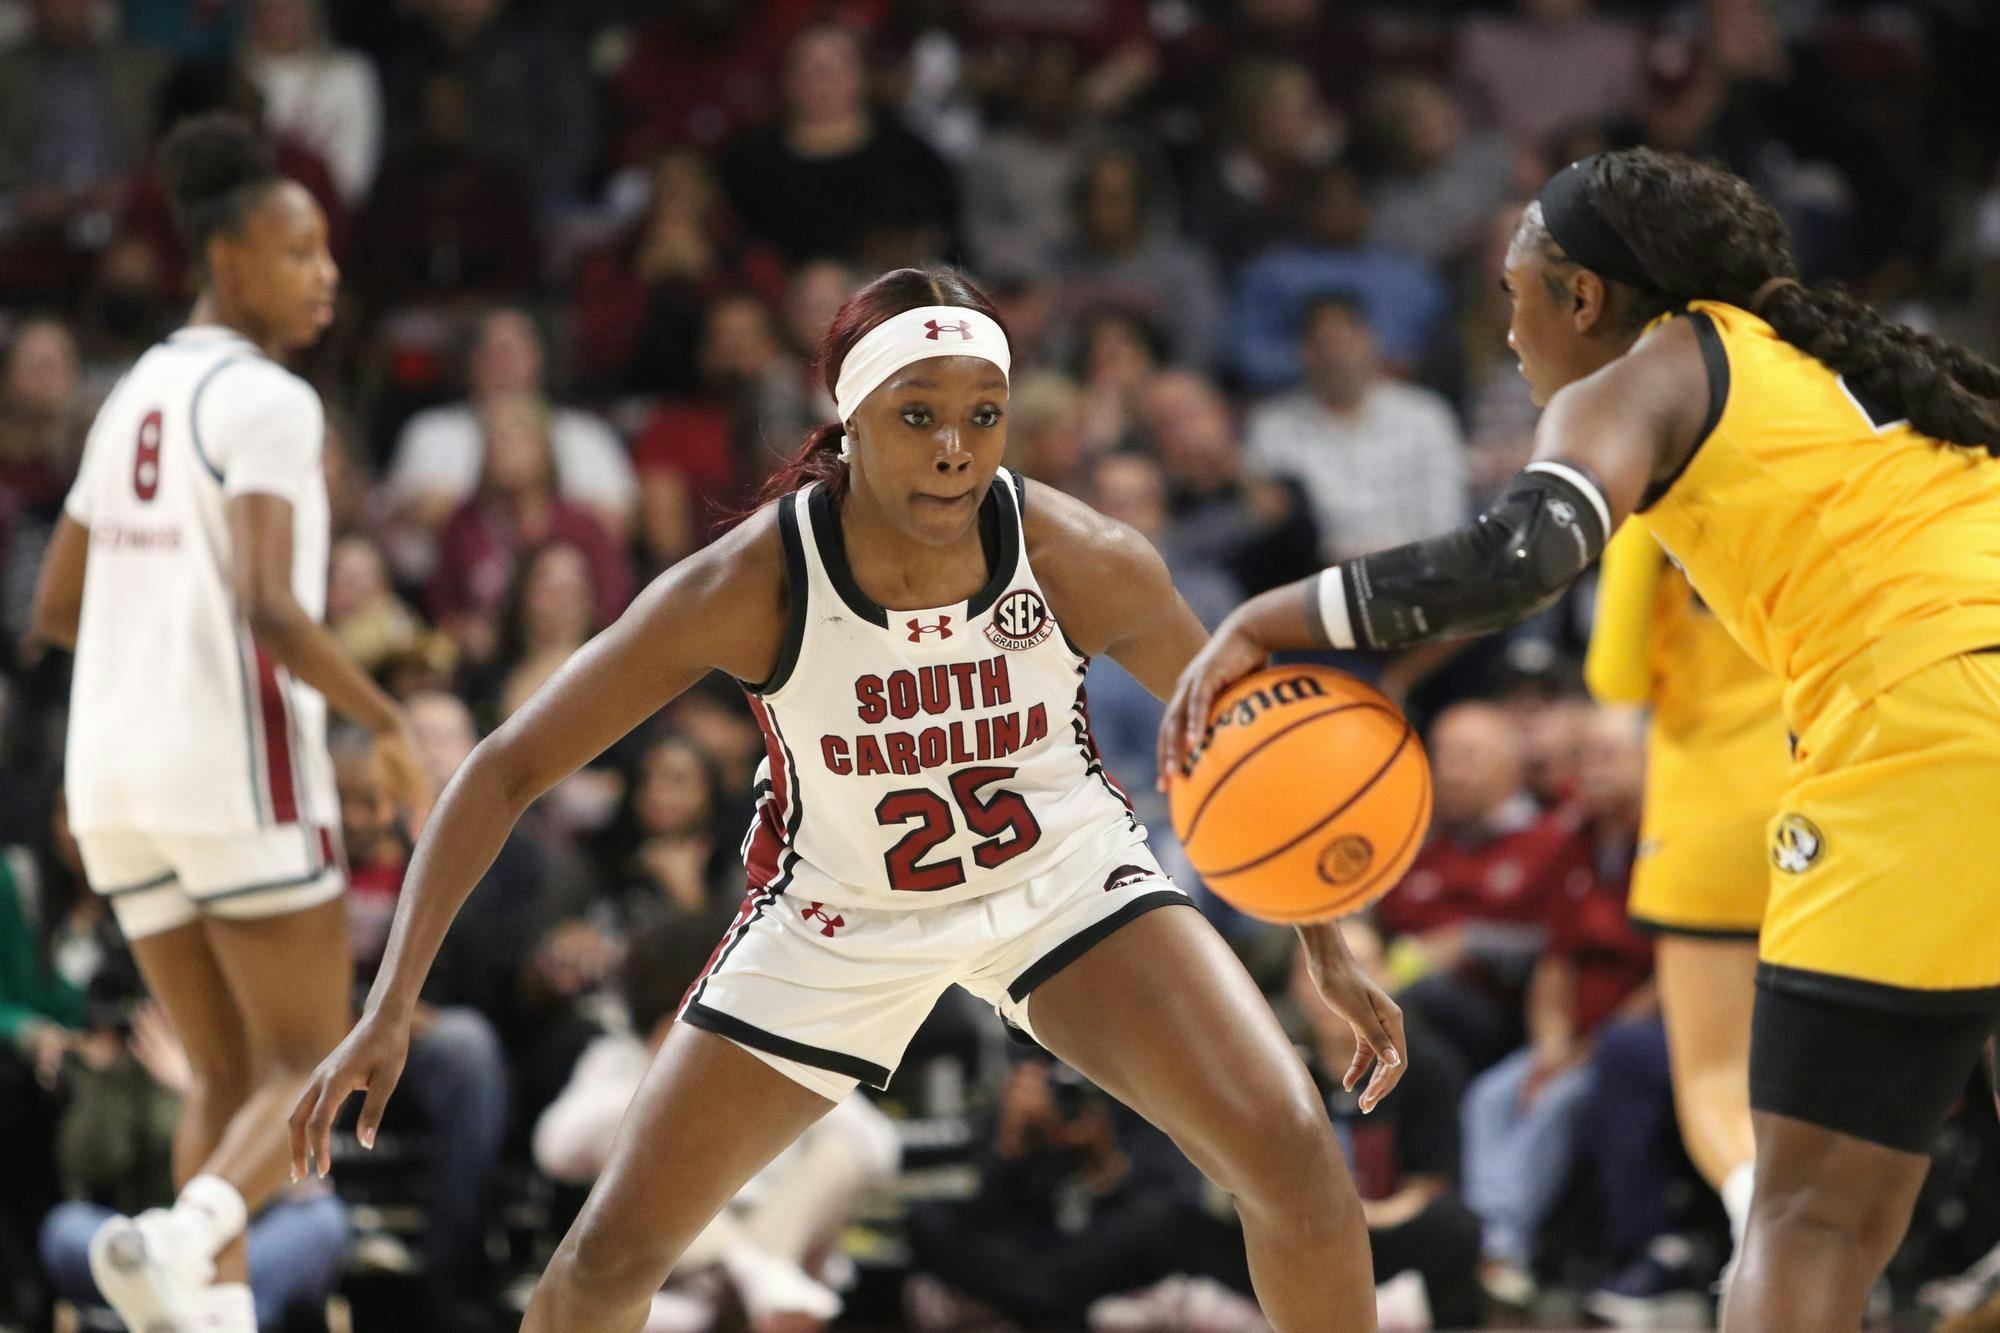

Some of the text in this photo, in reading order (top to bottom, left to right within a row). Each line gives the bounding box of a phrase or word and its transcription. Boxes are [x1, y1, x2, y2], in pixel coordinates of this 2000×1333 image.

[134, 411, 163, 502] 8
[993, 629, 1048, 649] GRADUATE
[998, 593, 1042, 635] SEC
[855, 654, 1012, 724] SOUTH
[820, 702, 1049, 776] CAROLINA
[874, 766, 1042, 891] 25
